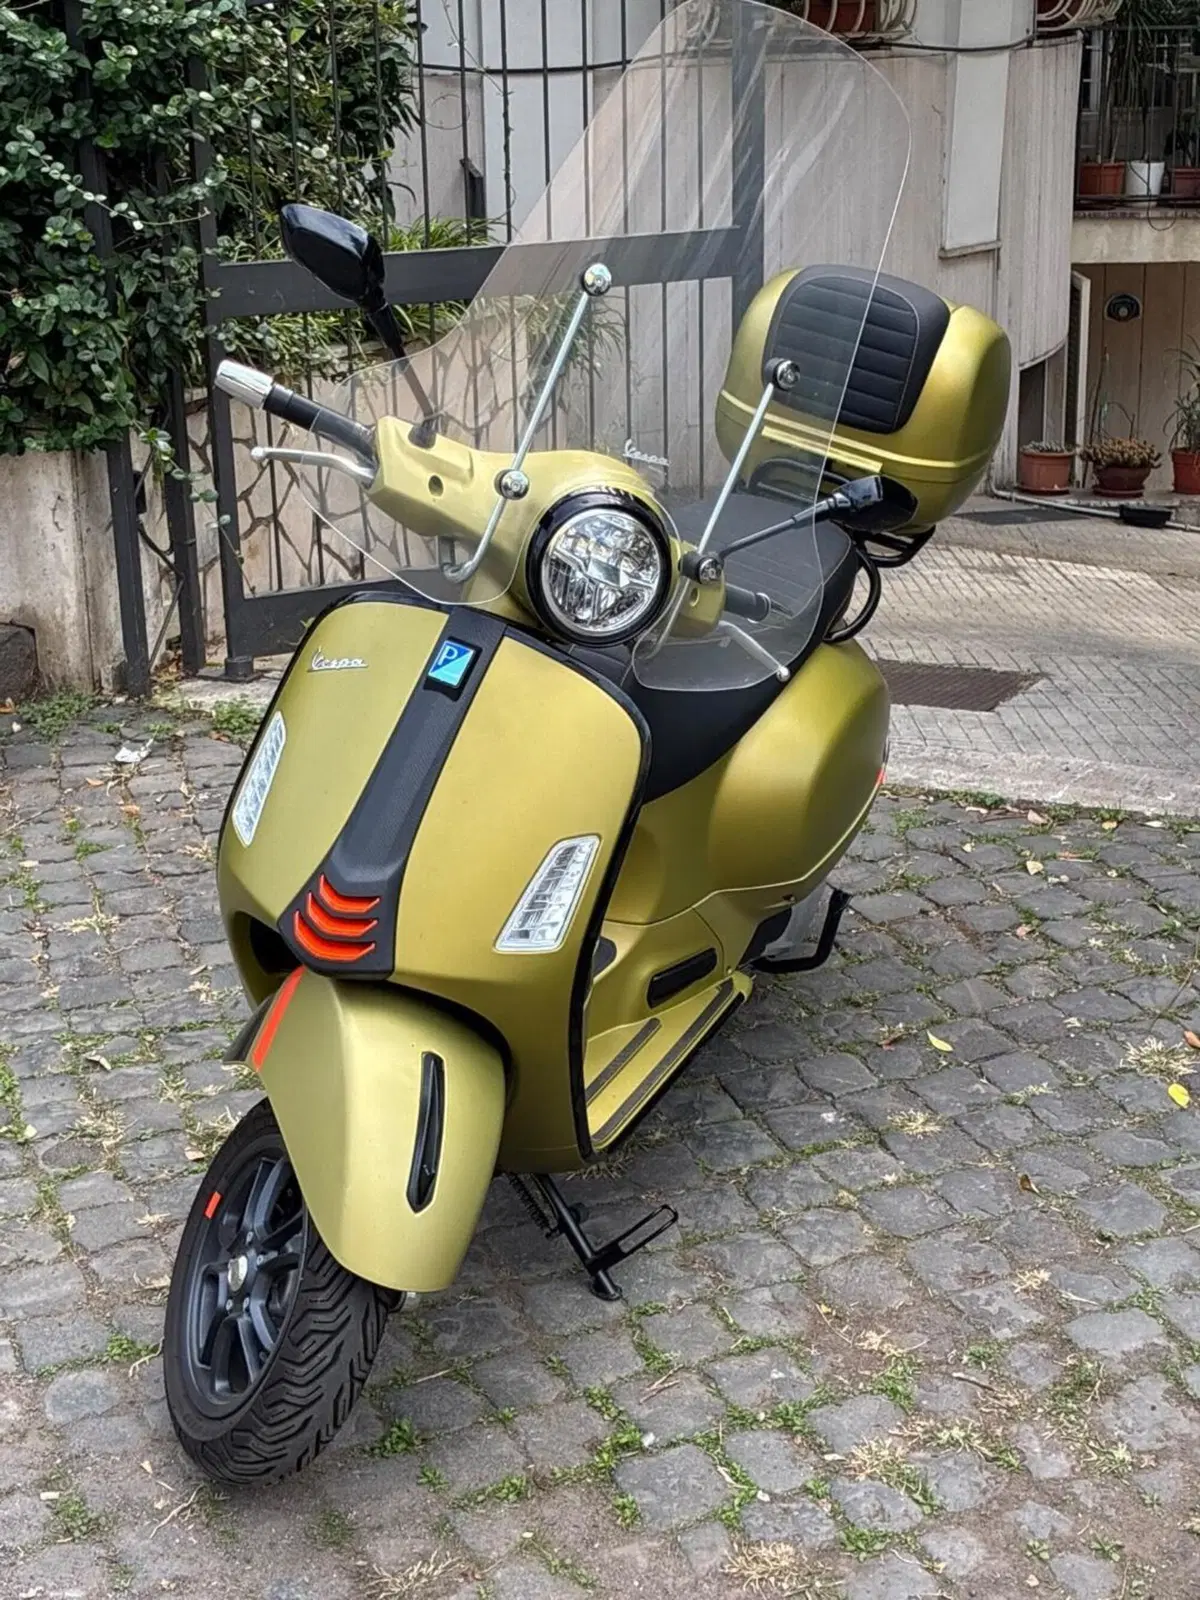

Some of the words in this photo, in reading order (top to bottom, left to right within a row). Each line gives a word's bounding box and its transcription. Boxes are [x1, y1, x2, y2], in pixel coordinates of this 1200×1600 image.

[622, 438, 670, 467] Vespa
[308, 645, 369, 672] Vespa
[437, 644, 458, 666] P
